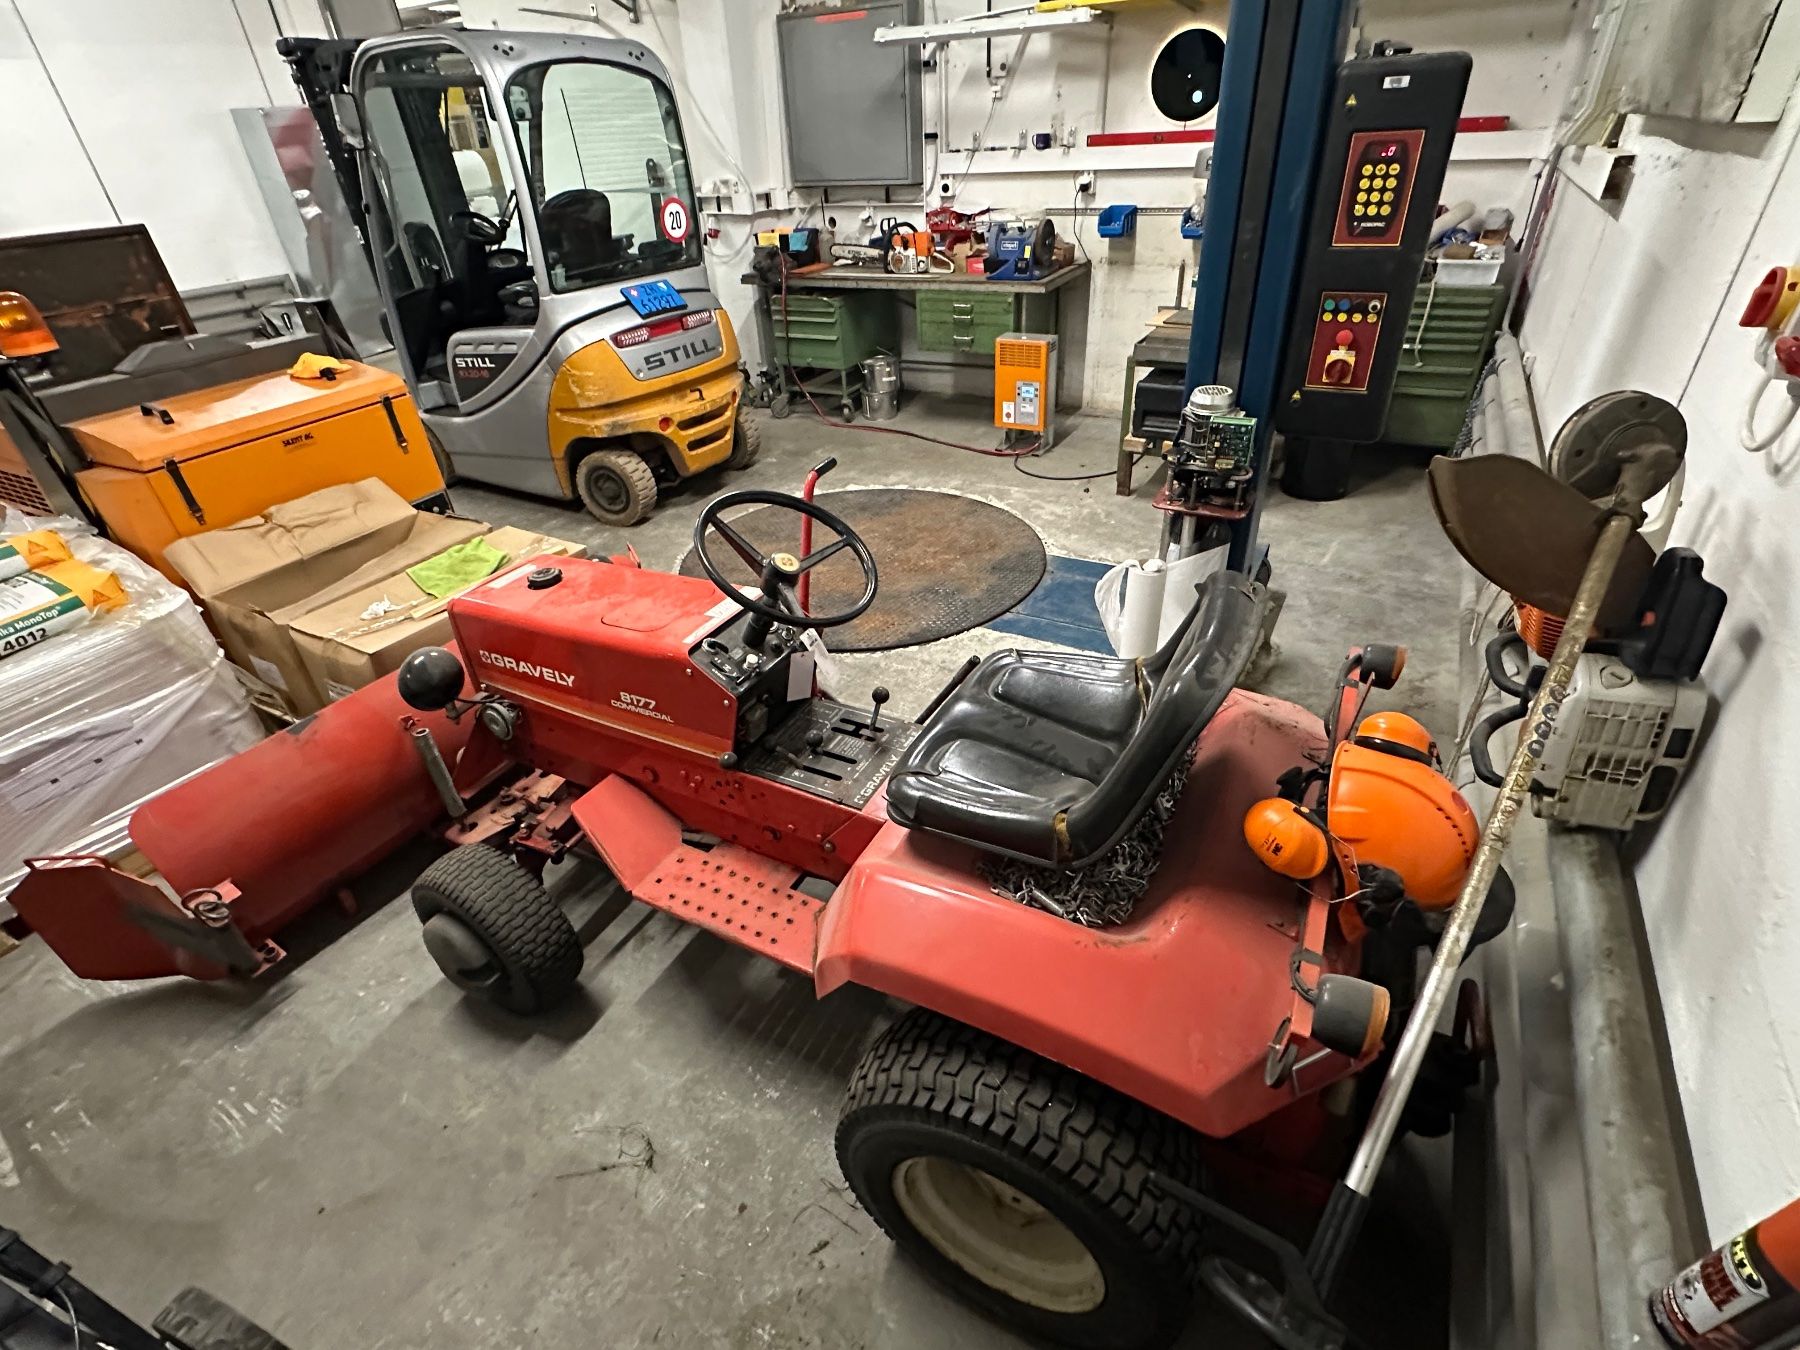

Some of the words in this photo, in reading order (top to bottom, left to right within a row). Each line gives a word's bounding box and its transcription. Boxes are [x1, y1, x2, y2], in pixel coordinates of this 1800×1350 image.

[669, 210, 682, 230] 20
[455, 357, 496, 368] STILL
[643, 338, 716, 371] STILL
[490, 653, 575, 687] GRAVELY
[610, 699, 674, 723] COMMERCIAL
[620, 691, 656, 709] 8177
